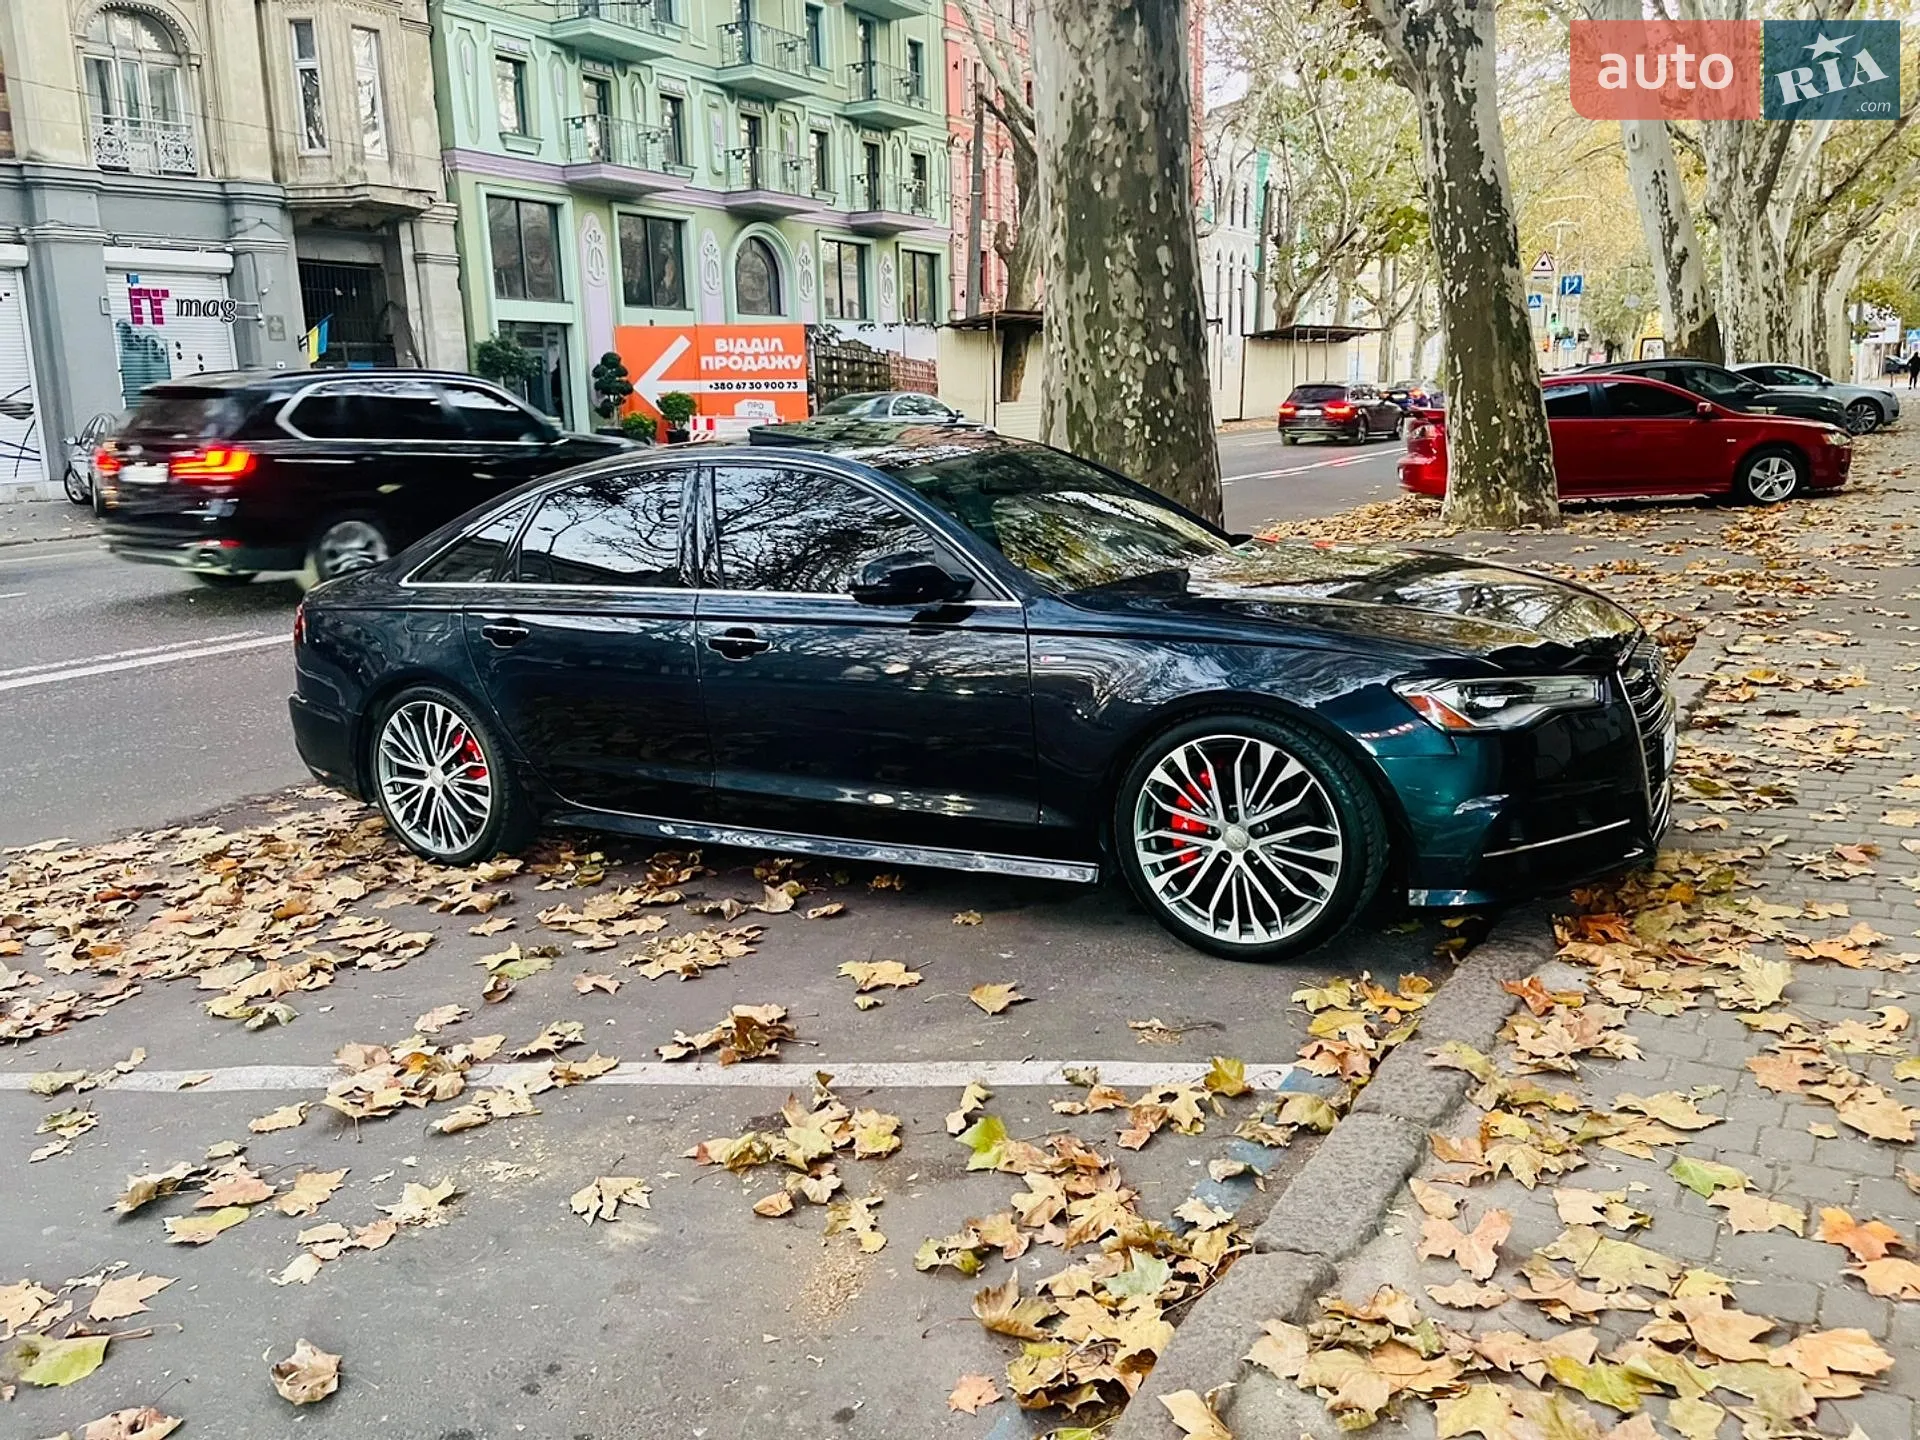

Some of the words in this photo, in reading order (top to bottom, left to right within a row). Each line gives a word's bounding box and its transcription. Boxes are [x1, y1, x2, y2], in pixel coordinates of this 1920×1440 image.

[175, 297, 239, 323] mag
[714, 337, 784, 354] ВІДДІЛ
[700, 354, 803, 372] ПРОДАЖУ
[709, 382, 733, 390] +380
[735, 382, 746, 390] 67
[749, 382, 762, 390] 30
[764, 381, 785, 389] 900
[787, 381, 798, 389] 73
